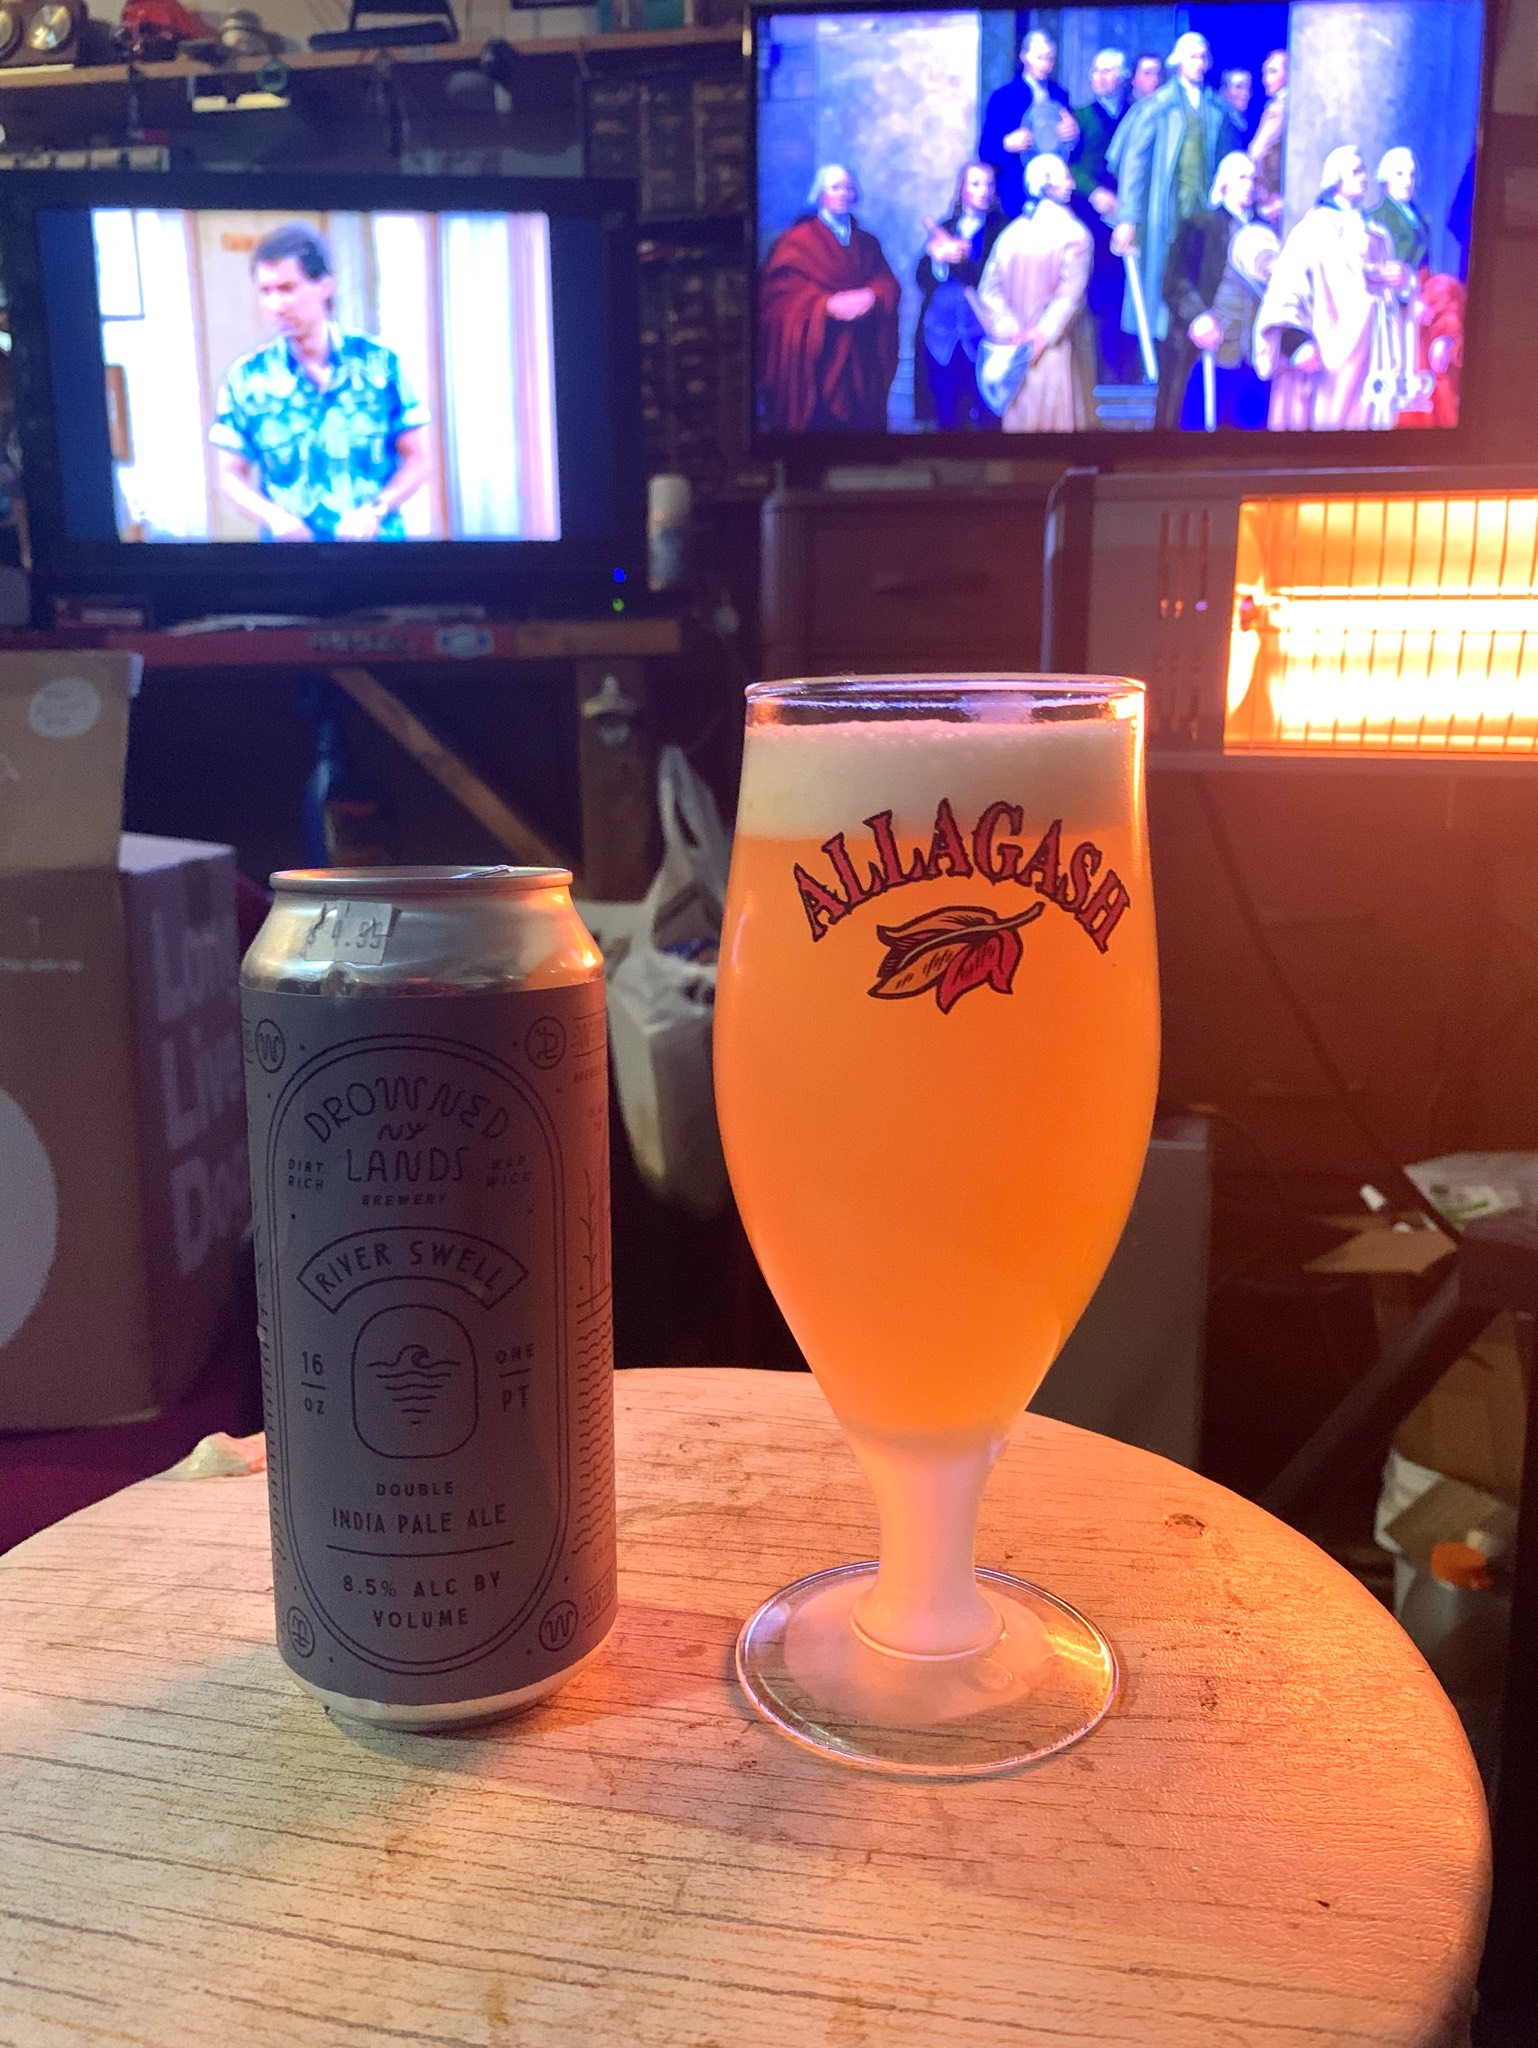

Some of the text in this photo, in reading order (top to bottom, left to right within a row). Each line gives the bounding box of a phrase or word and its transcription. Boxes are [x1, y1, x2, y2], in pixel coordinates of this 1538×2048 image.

[794, 798, 1131, 954] ALLAGASH
[305, 1075, 509, 1143] DROWNED
[377, 1120, 428, 1142] NY
[288, 1158, 324, 1174] DIRT
[347, 1147, 470, 1183] LANDS
[287, 1174, 324, 1190] RICH
[362, 1192, 447, 1206] BREWERY
[315, 1240, 502, 1294] RIVER SWELL
[301, 1351, 324, 1376] 16
[496, 1345, 533, 1364] ONE
[304, 1394, 324, 1415] OZ
[502, 1385, 530, 1413] PT
[376, 1482, 454, 1497] DOUBLE
[332, 1503, 507, 1535] INDIA PALE ALE
[342, 1571, 501, 1598] 8.5% ALC BY
[372, 1607, 468, 1630] VOLUME
